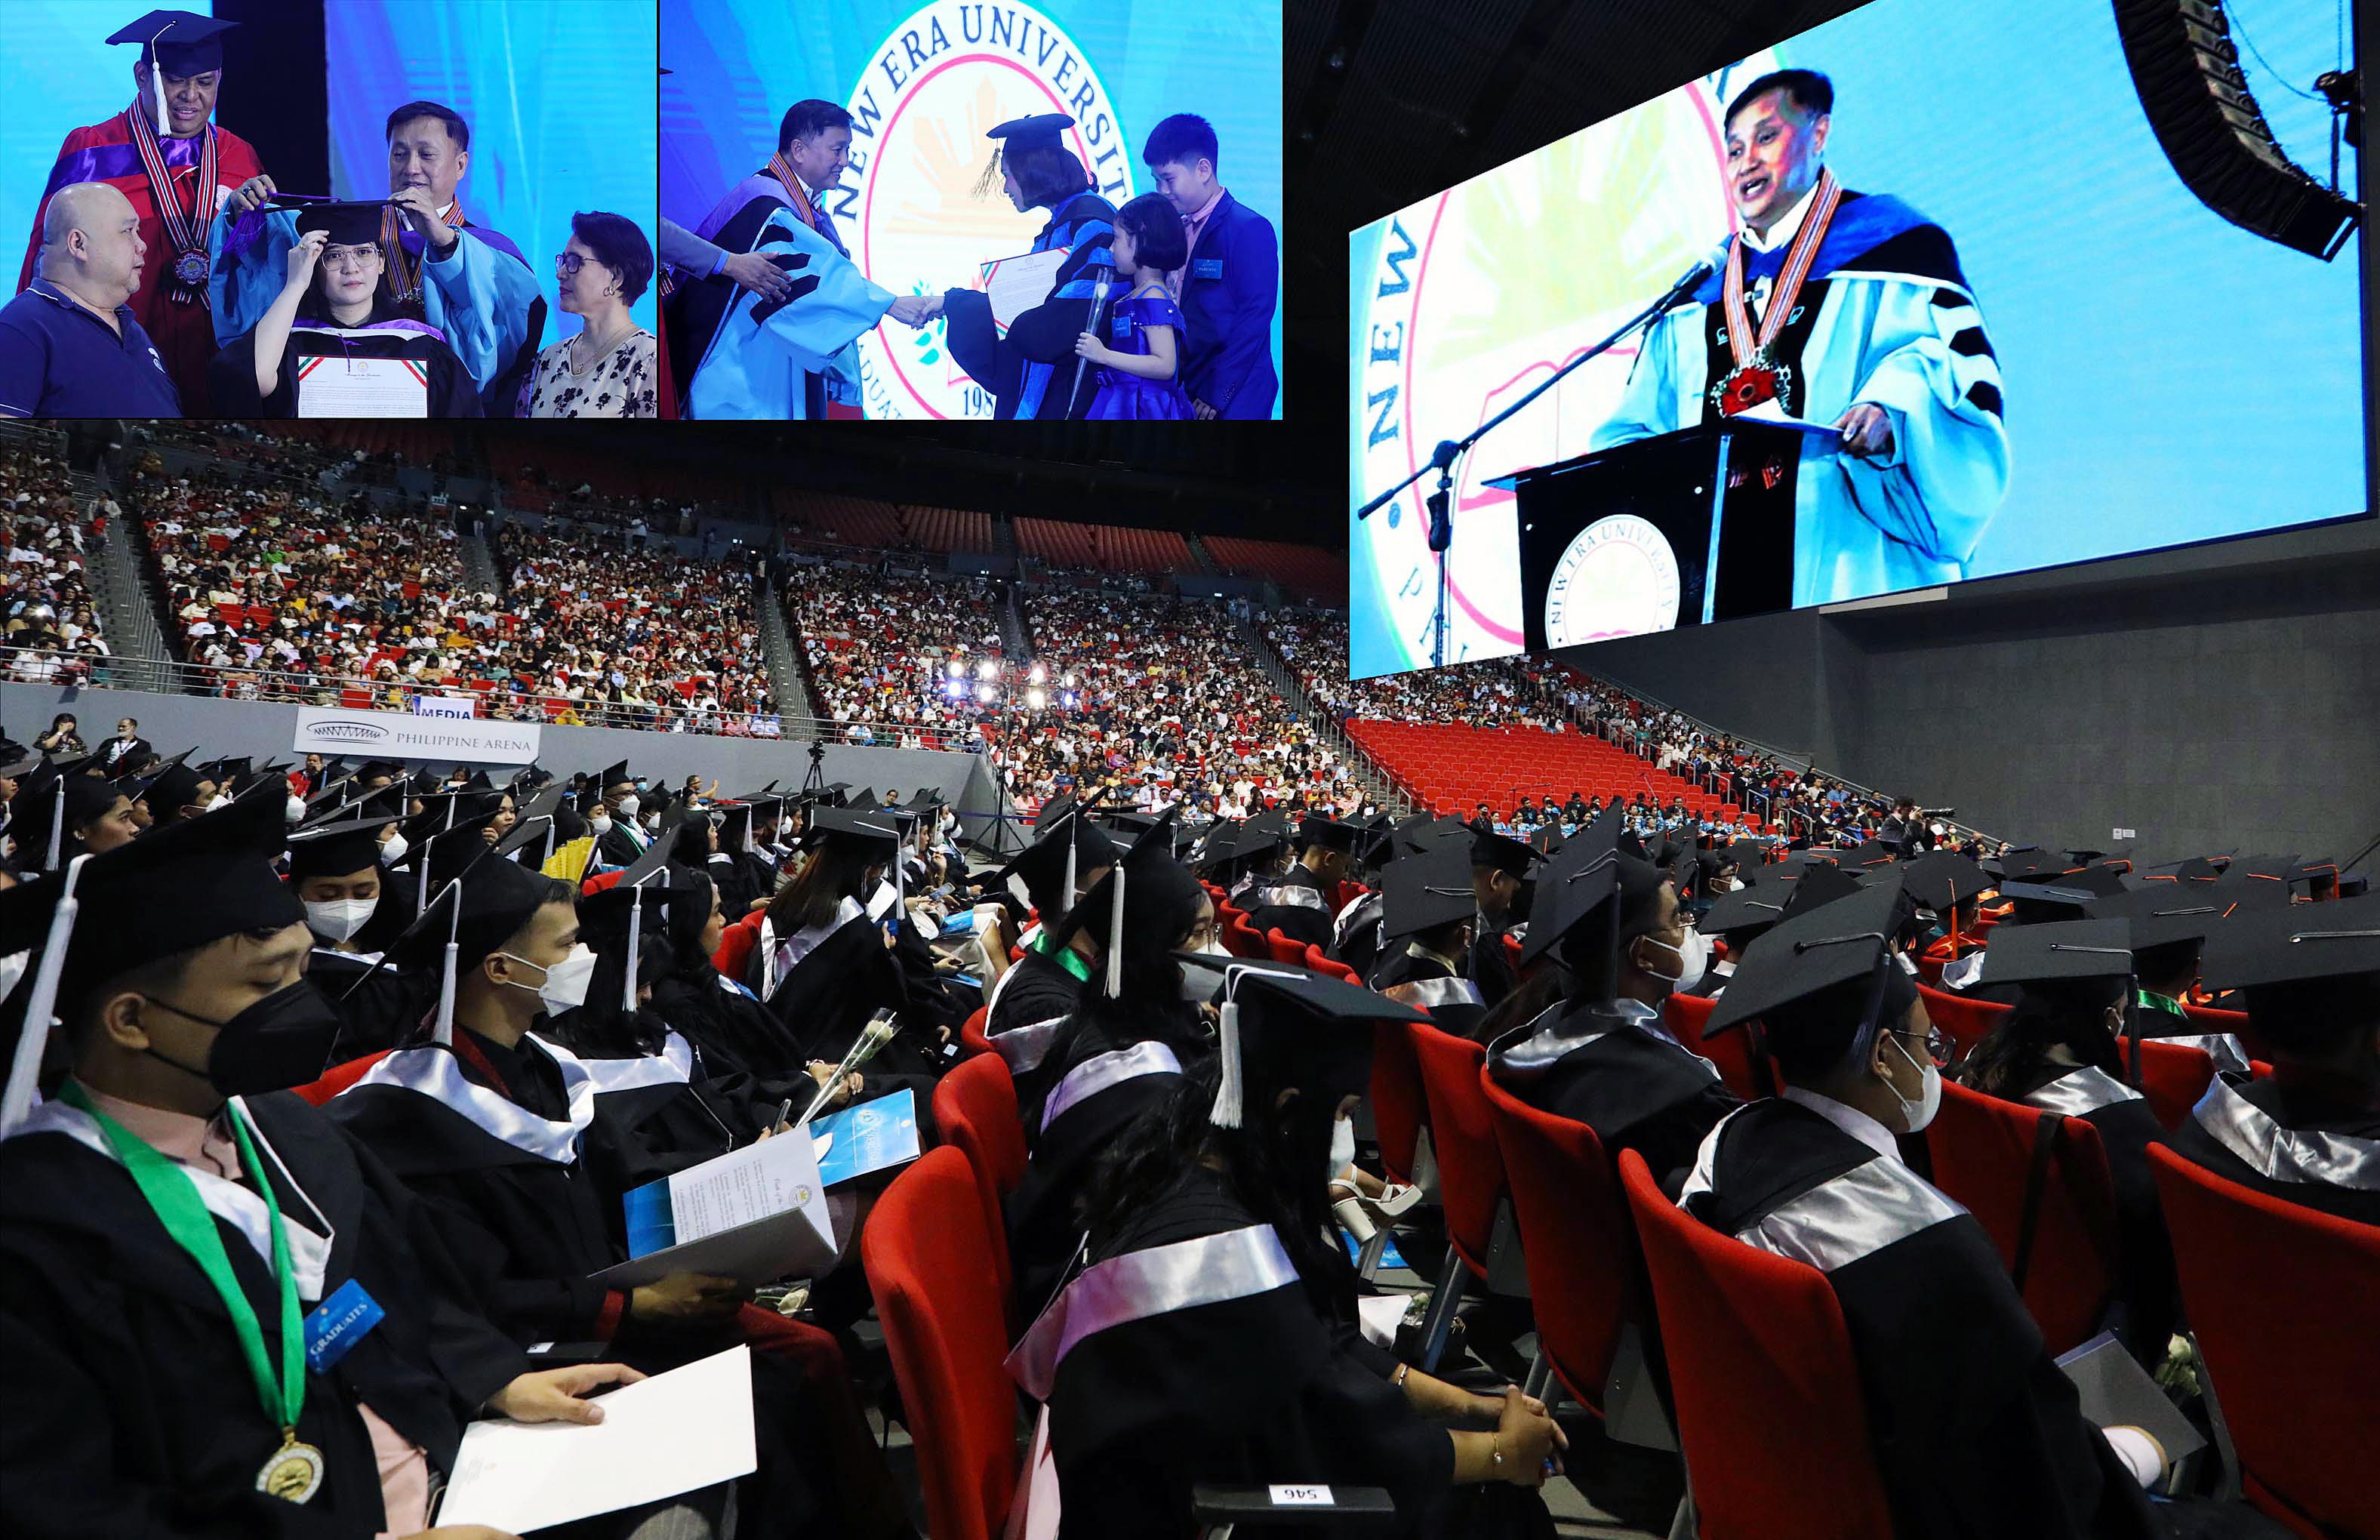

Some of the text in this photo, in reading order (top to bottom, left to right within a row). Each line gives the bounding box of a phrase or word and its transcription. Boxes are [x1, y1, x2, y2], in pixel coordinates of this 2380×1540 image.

[833, 5, 1128, 222] NEW ERA UNIVERSIT
[1368, 215, 1418, 453] NEW
[421, 708, 471, 720] MEDIA
[396, 732, 531, 751] PHILIPPINE ARENA
[309, 1304, 368, 1355] GRADUATES
[1285, 1489, 1317, 1499] 546
